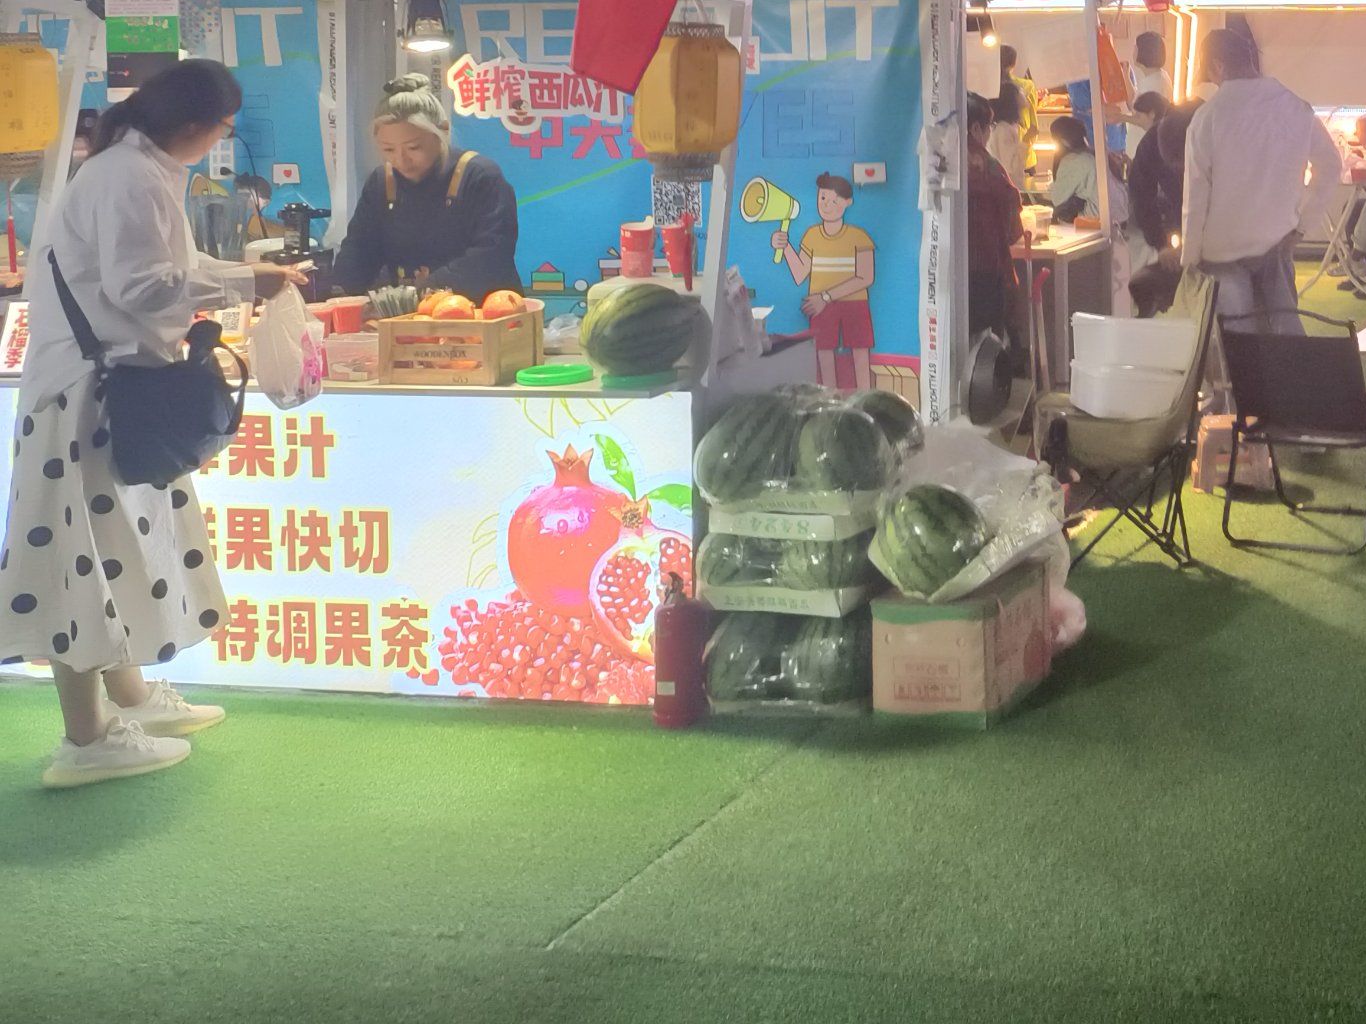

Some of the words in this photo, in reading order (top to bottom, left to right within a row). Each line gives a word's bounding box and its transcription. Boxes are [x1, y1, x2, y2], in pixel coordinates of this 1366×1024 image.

[453, 62, 619, 117] 鲜榨西瓜汁
[211, 598, 428, 669] 特调果茶
